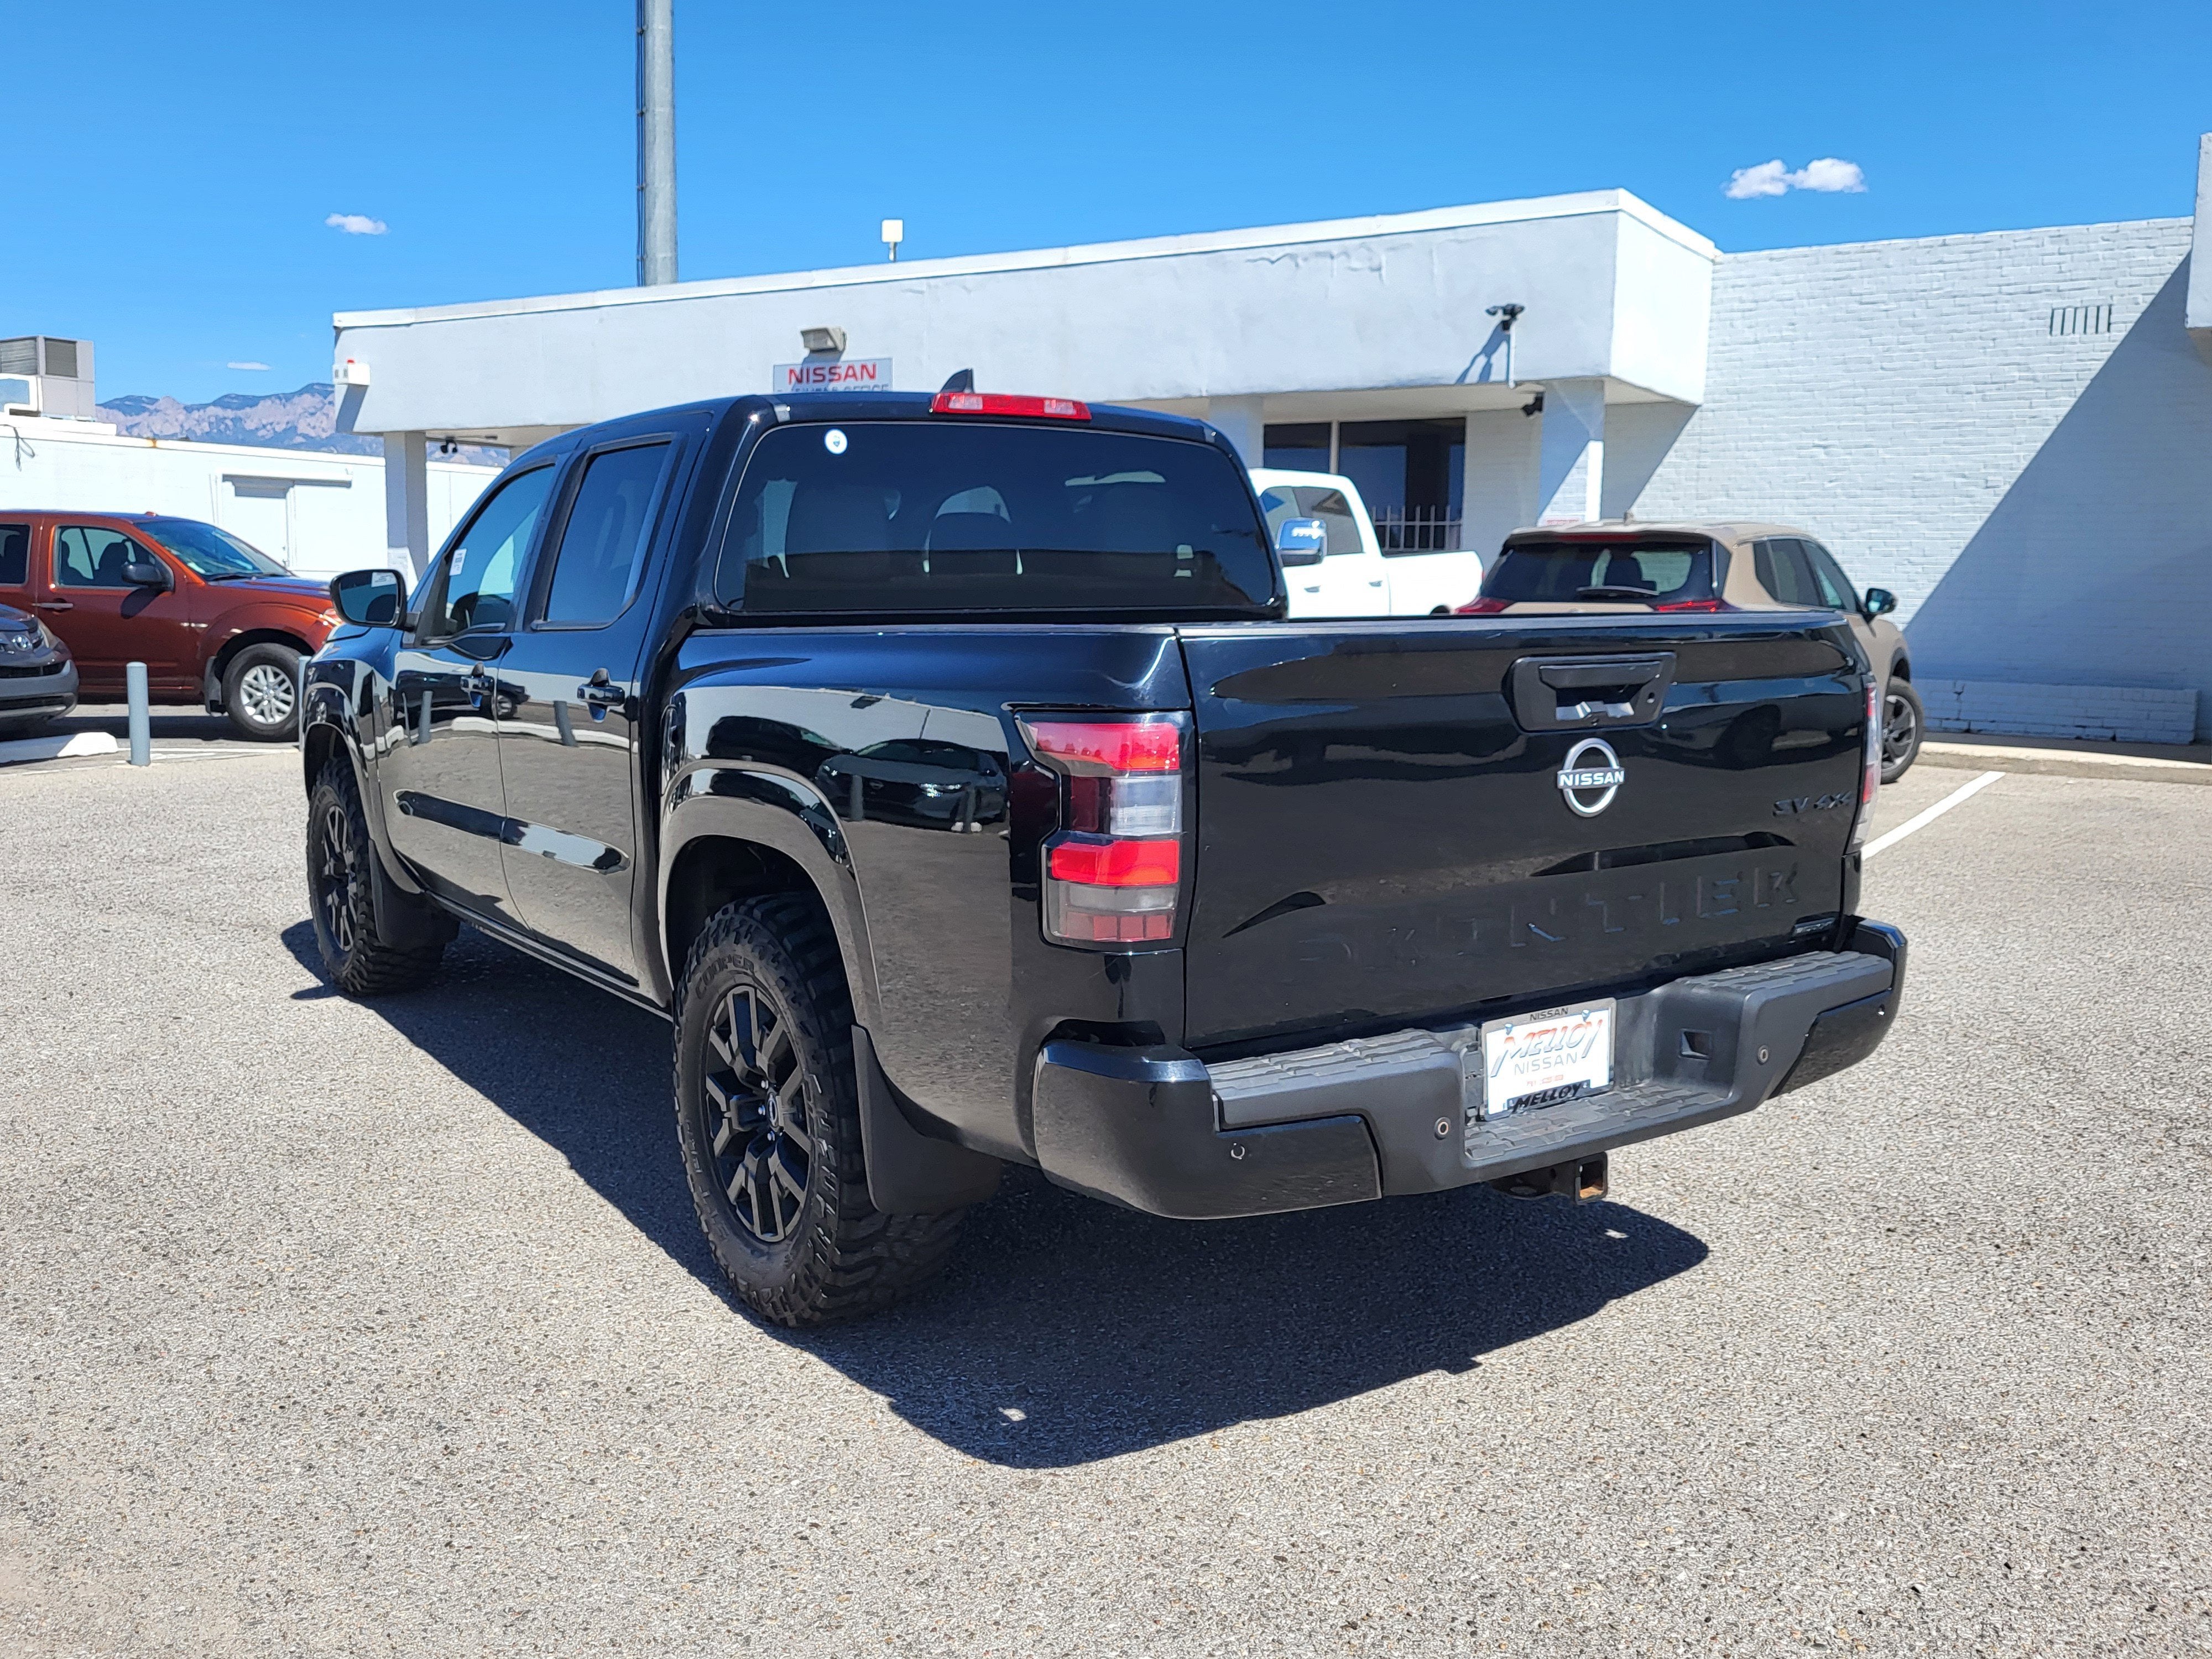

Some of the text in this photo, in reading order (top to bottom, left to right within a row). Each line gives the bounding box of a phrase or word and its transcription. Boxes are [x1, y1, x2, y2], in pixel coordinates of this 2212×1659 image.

[788, 363, 877, 385] NISSAN
[1559, 770, 1624, 786] NISSAN
[1772, 796, 1809, 817] SV
[696, 954, 754, 1000] COOPER
[1530, 1008, 1569, 1021] NISSAN
[1514, 1052, 1578, 1076] NISSAN
[1511, 1083, 1582, 1113] MELLOY
